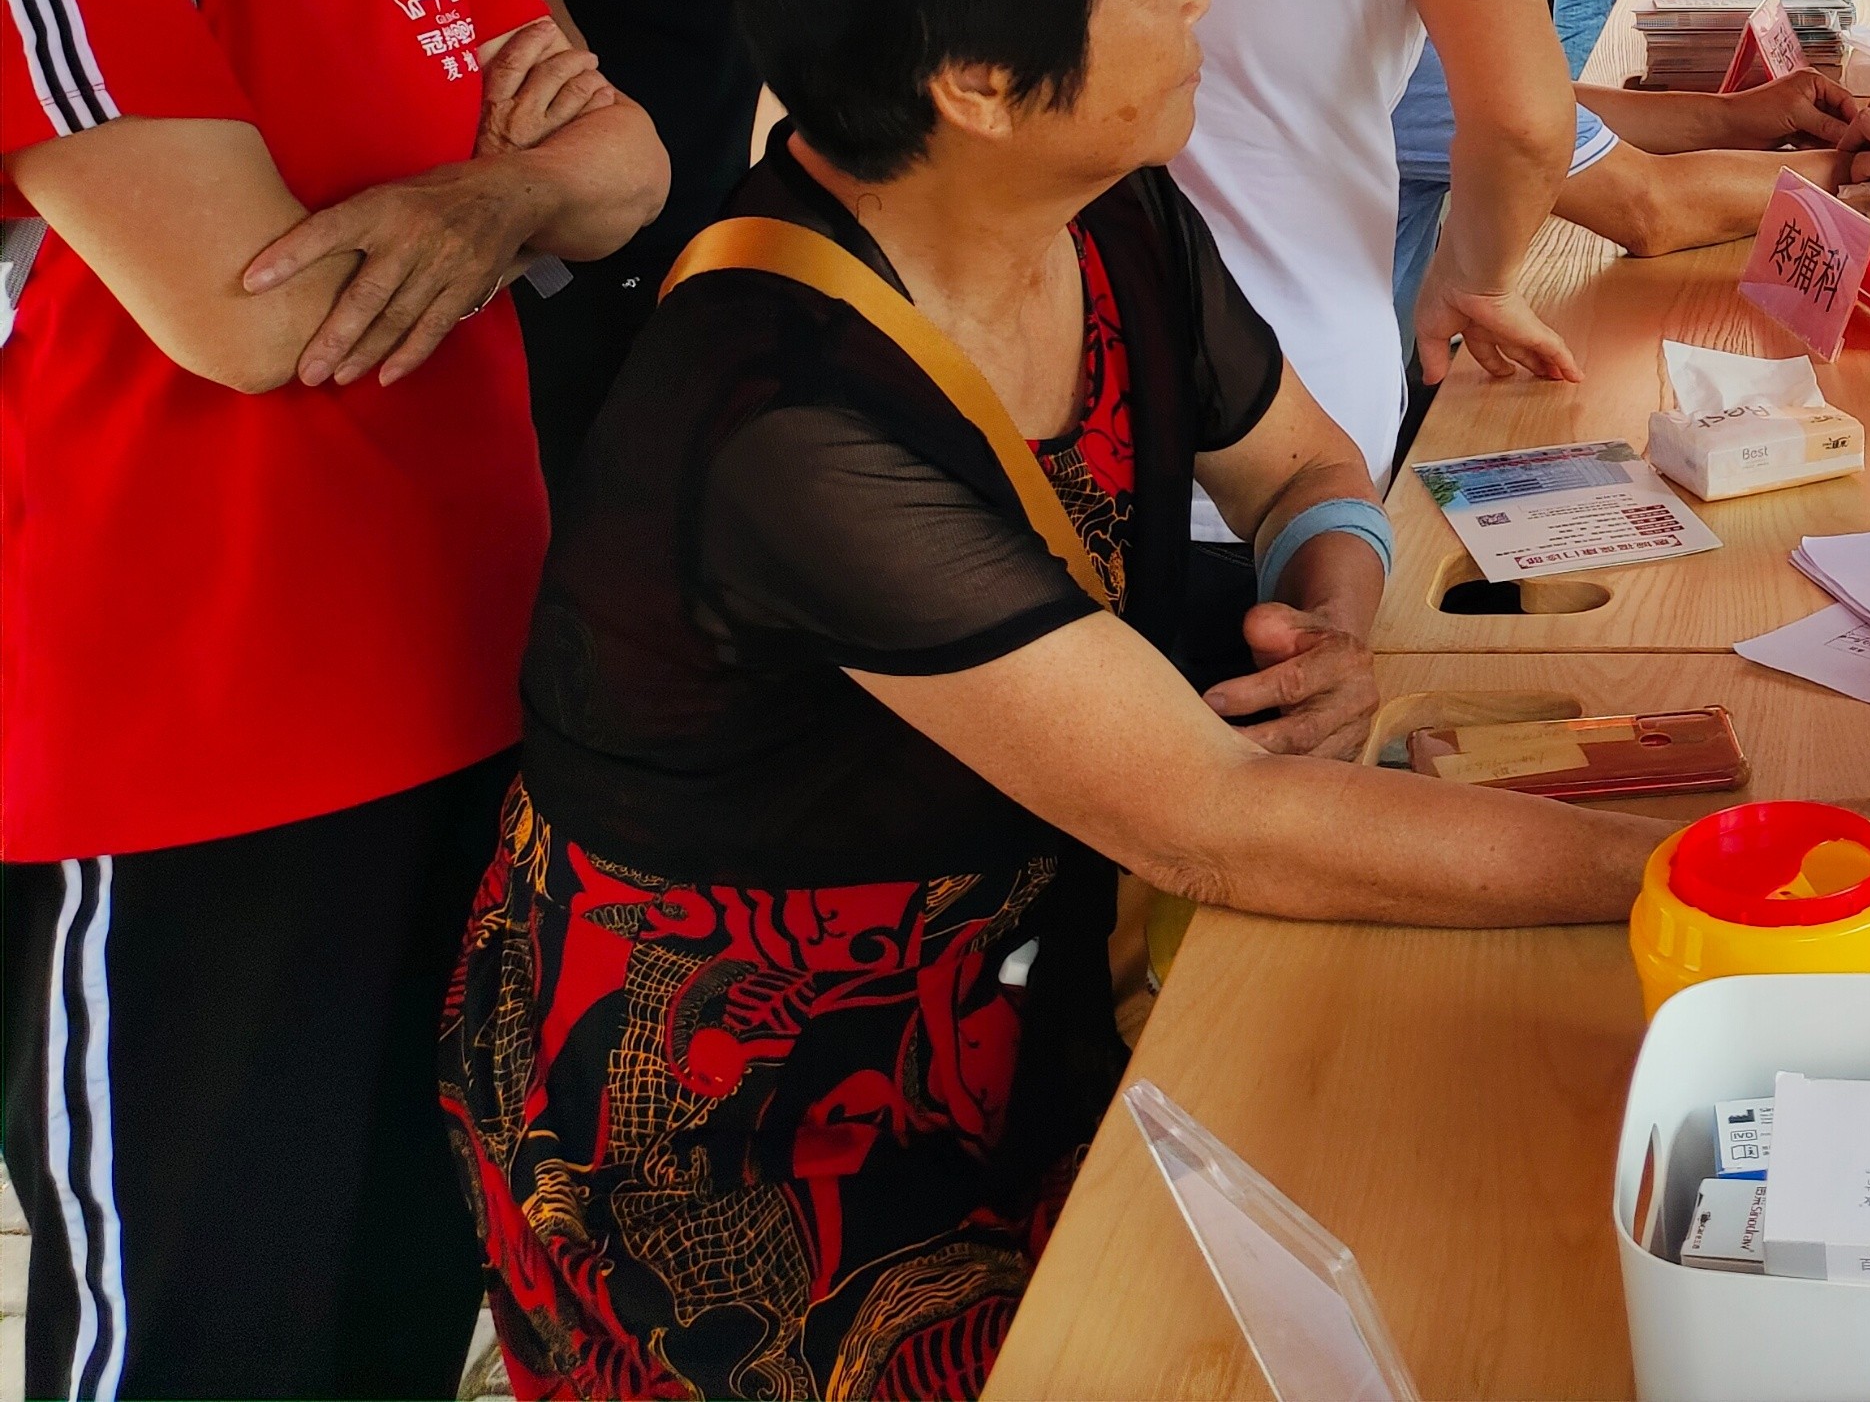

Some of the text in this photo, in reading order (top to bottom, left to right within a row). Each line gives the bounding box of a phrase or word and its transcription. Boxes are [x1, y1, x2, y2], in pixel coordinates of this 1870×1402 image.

[1768, 217, 1850, 313] 疼痛科
[1742, 445, 1769, 460] Best
